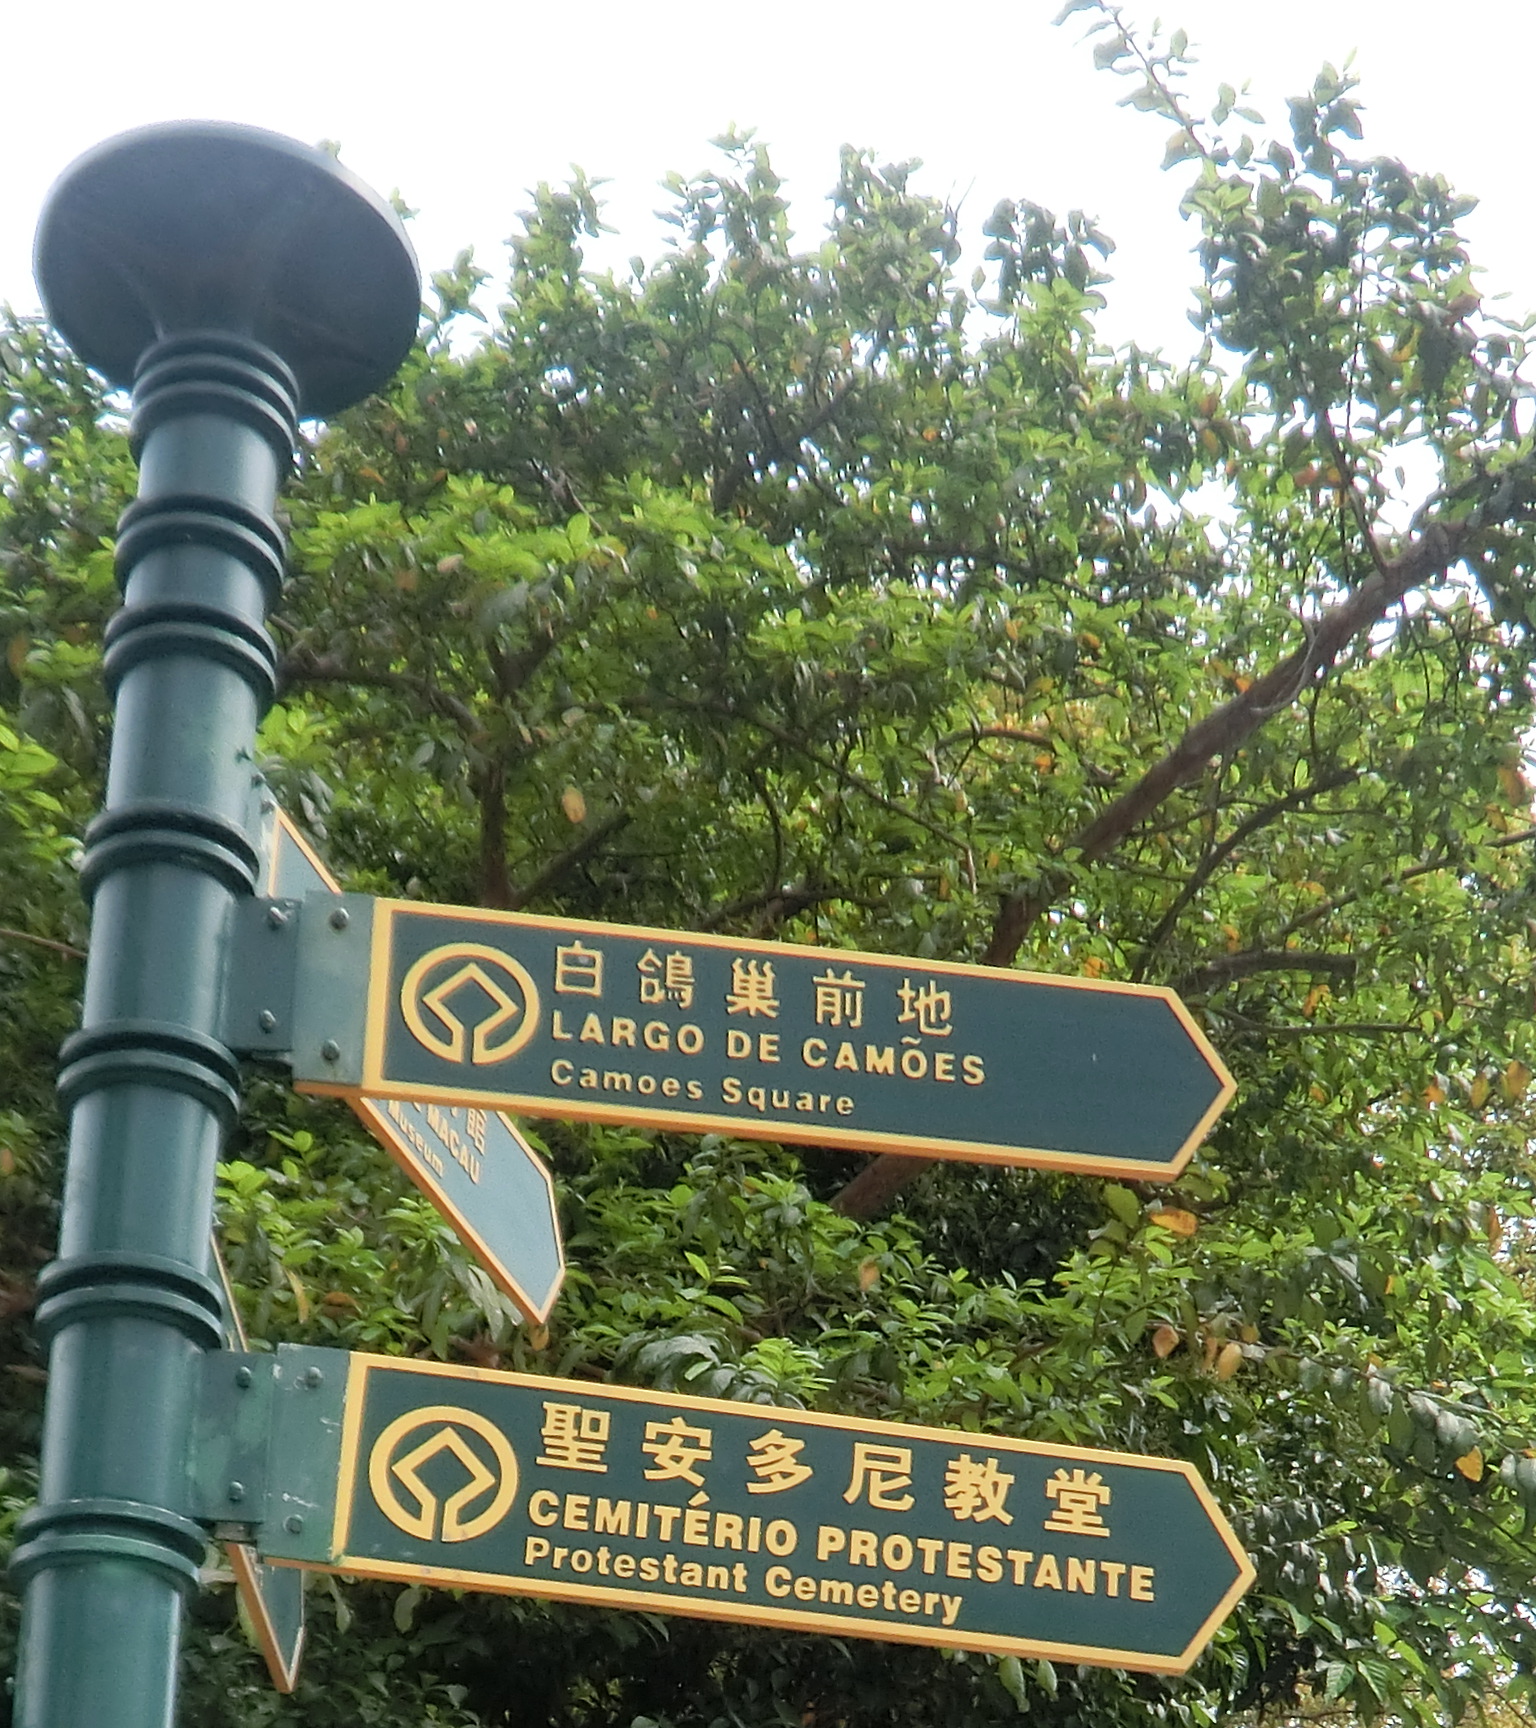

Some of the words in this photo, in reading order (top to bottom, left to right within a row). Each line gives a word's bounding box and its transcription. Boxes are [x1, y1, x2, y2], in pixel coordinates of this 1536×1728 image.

[554, 939, 953, 1037] 白鴿巢前地
[550, 1058, 704, 1101] Camoes
[722, 1076, 855, 1116] Square
[552, 1009, 705, 1056] LARGO
[726, 1029, 781, 1063] DE
[802, 1035, 986, 1086] CAMÕES
[387, 1099, 443, 1179] Museum
[426, 1103, 481, 1185] MACAU
[535, 1400, 1112, 1538] 聖安多尼教堂
[524, 1535, 748, 1593] Protestant
[764, 1565, 963, 1626] Cemetery
[528, 1489, 799, 1557] CEMITÉRIO
[816, 1525, 1156, 1602] PROTESTANTE
